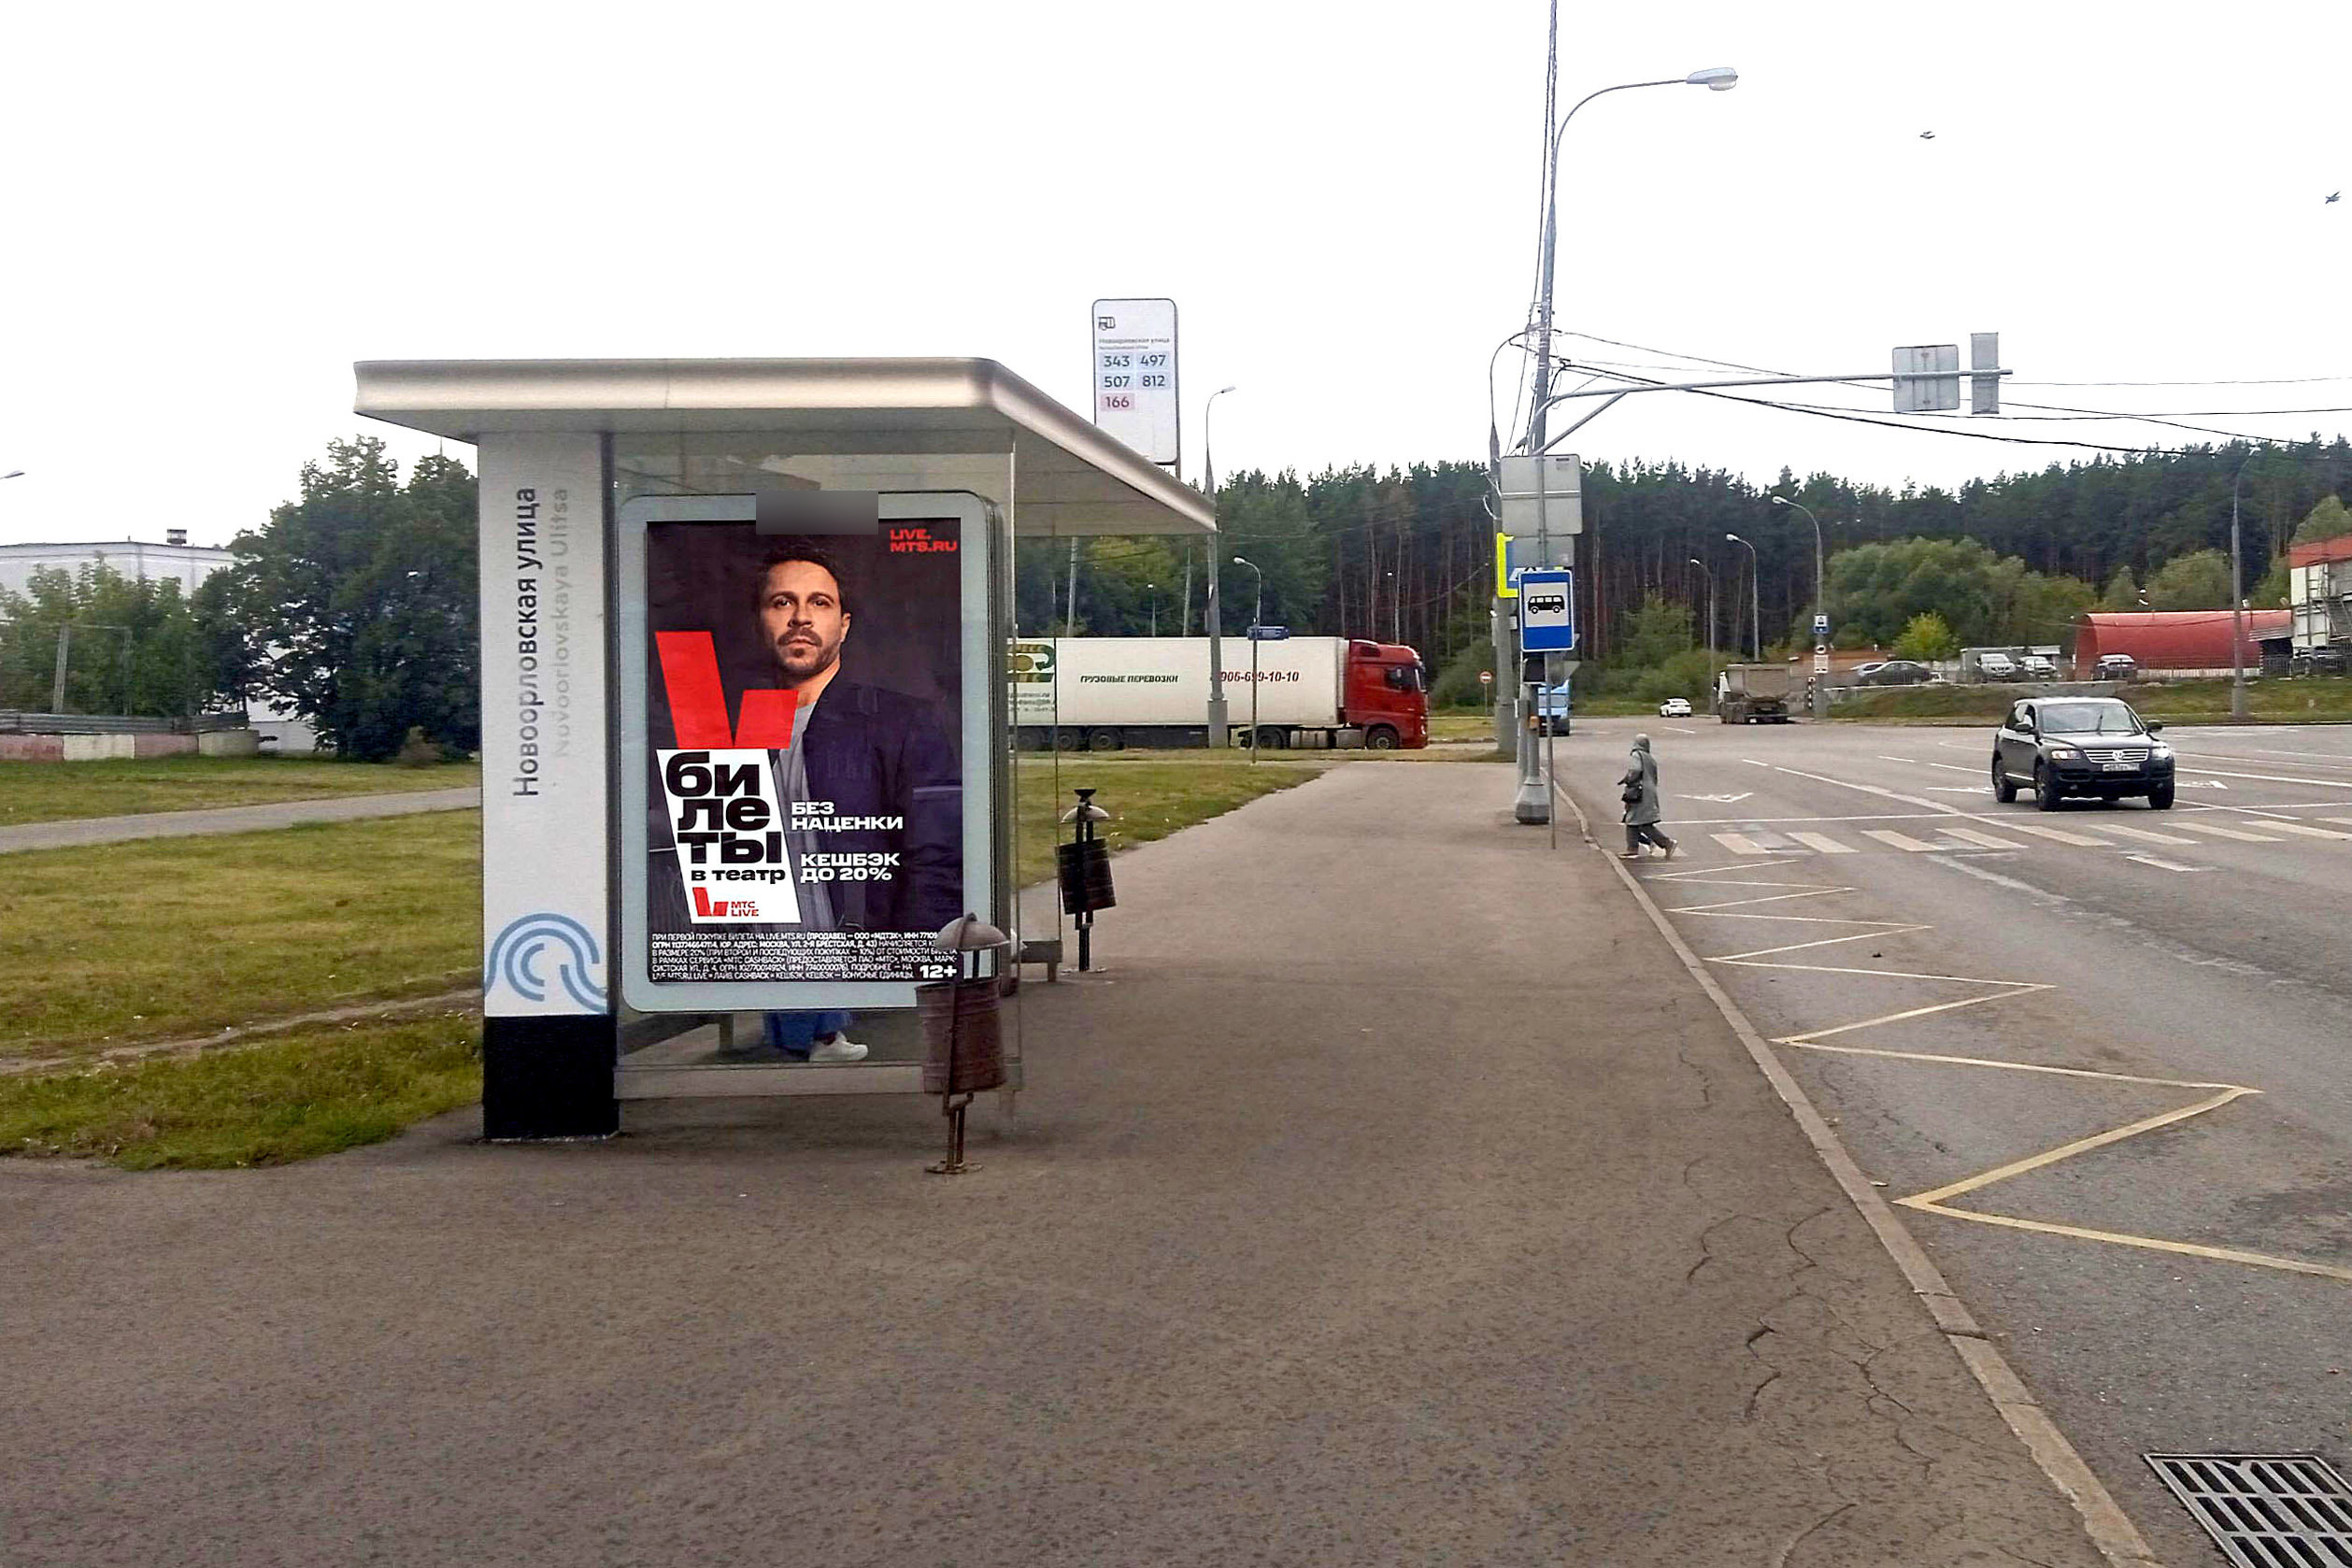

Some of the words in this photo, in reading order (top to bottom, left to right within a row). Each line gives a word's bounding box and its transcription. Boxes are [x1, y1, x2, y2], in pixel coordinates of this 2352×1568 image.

[1104, 355, 1131, 367] 343
[1139, 354, 1167, 366] 497
[1105, 376, 1131, 388] 507
[1142, 375, 1165, 387] 812
[1105, 396, 1130, 408] 166
[517, 489, 543, 570] улица
[890, 528, 932, 540] LIVE.
[890, 540, 958, 552] MTS.RU
[1127, 675, 1178, 683] ПЕРЕВОЗКИ
[513, 578, 544, 796] Новоорловская
[666, 751, 760, 797] би
[677, 797, 770, 831] ле
[791, 801, 835, 816] БЕЗ
[791, 816, 904, 833] НАЦЕНКИ
[677, 831, 782, 863] ты
[801, 852, 901, 867] КЕШБЭК
[691, 870, 706, 881] в
[712, 869, 786, 884] театр
[800, 867, 835, 884] ДО
[839, 867, 892, 881] 20%
[668, 932, 695, 940] ПЕРВОЙ
[919, 964, 958, 979] 12+
